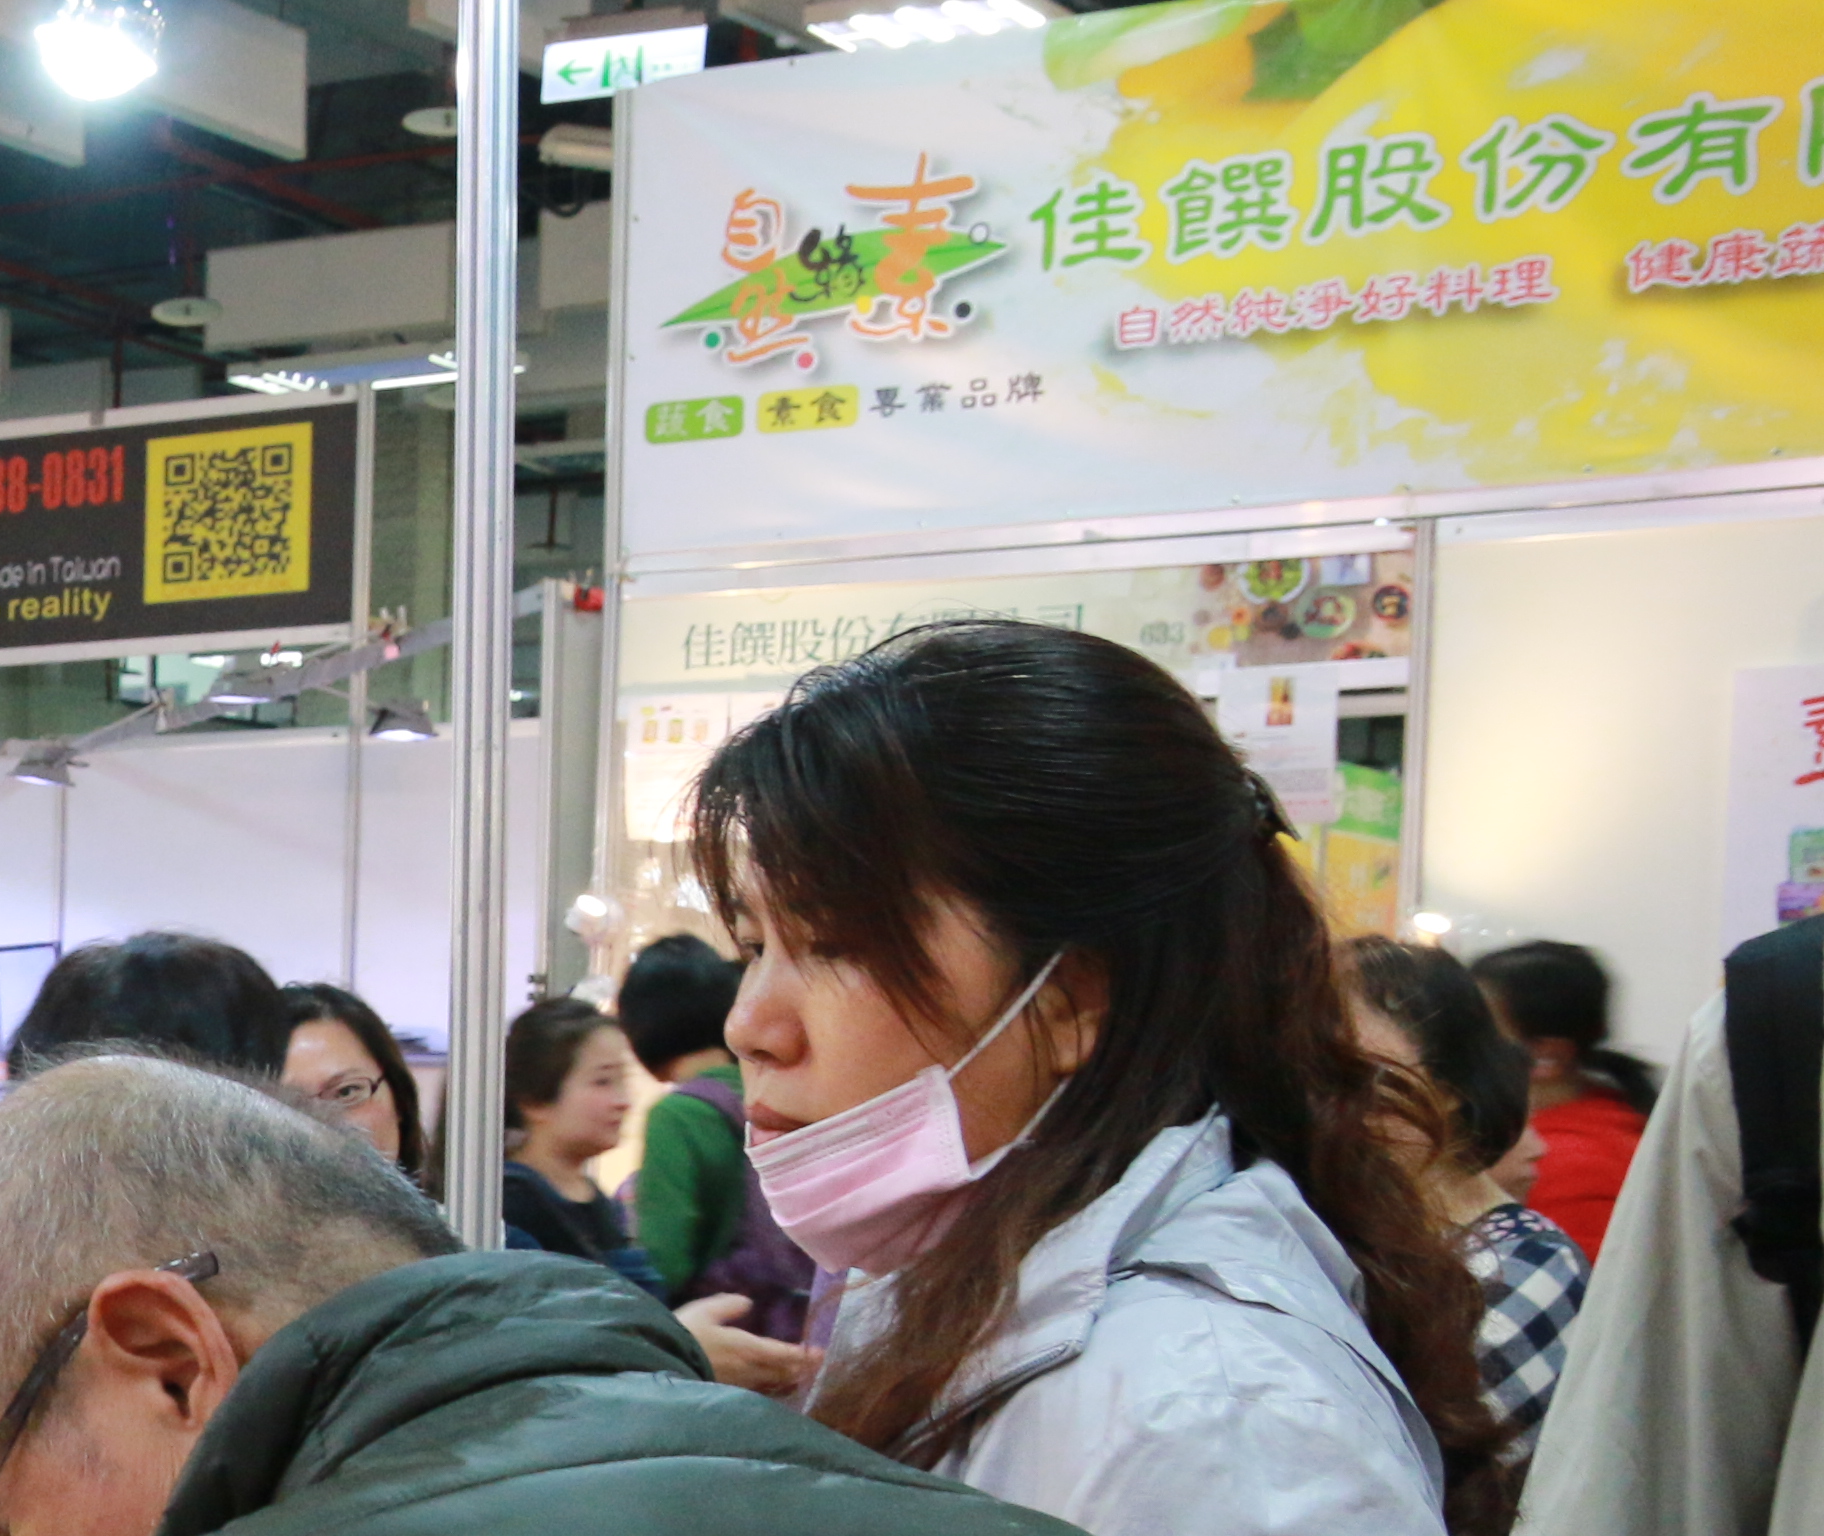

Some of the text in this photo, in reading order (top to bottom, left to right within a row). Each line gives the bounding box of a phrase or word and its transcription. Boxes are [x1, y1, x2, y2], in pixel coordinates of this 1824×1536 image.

[1029, 82, 1824, 272] 佳饌股份有
[1116, 258, 1553, 347] 自然純淨好料理
[764, 390, 849, 430] 素食
[26, 562, 45, 586] in
[52, 556, 120, 586] Taiwan
[8, 587, 113, 622] reality
